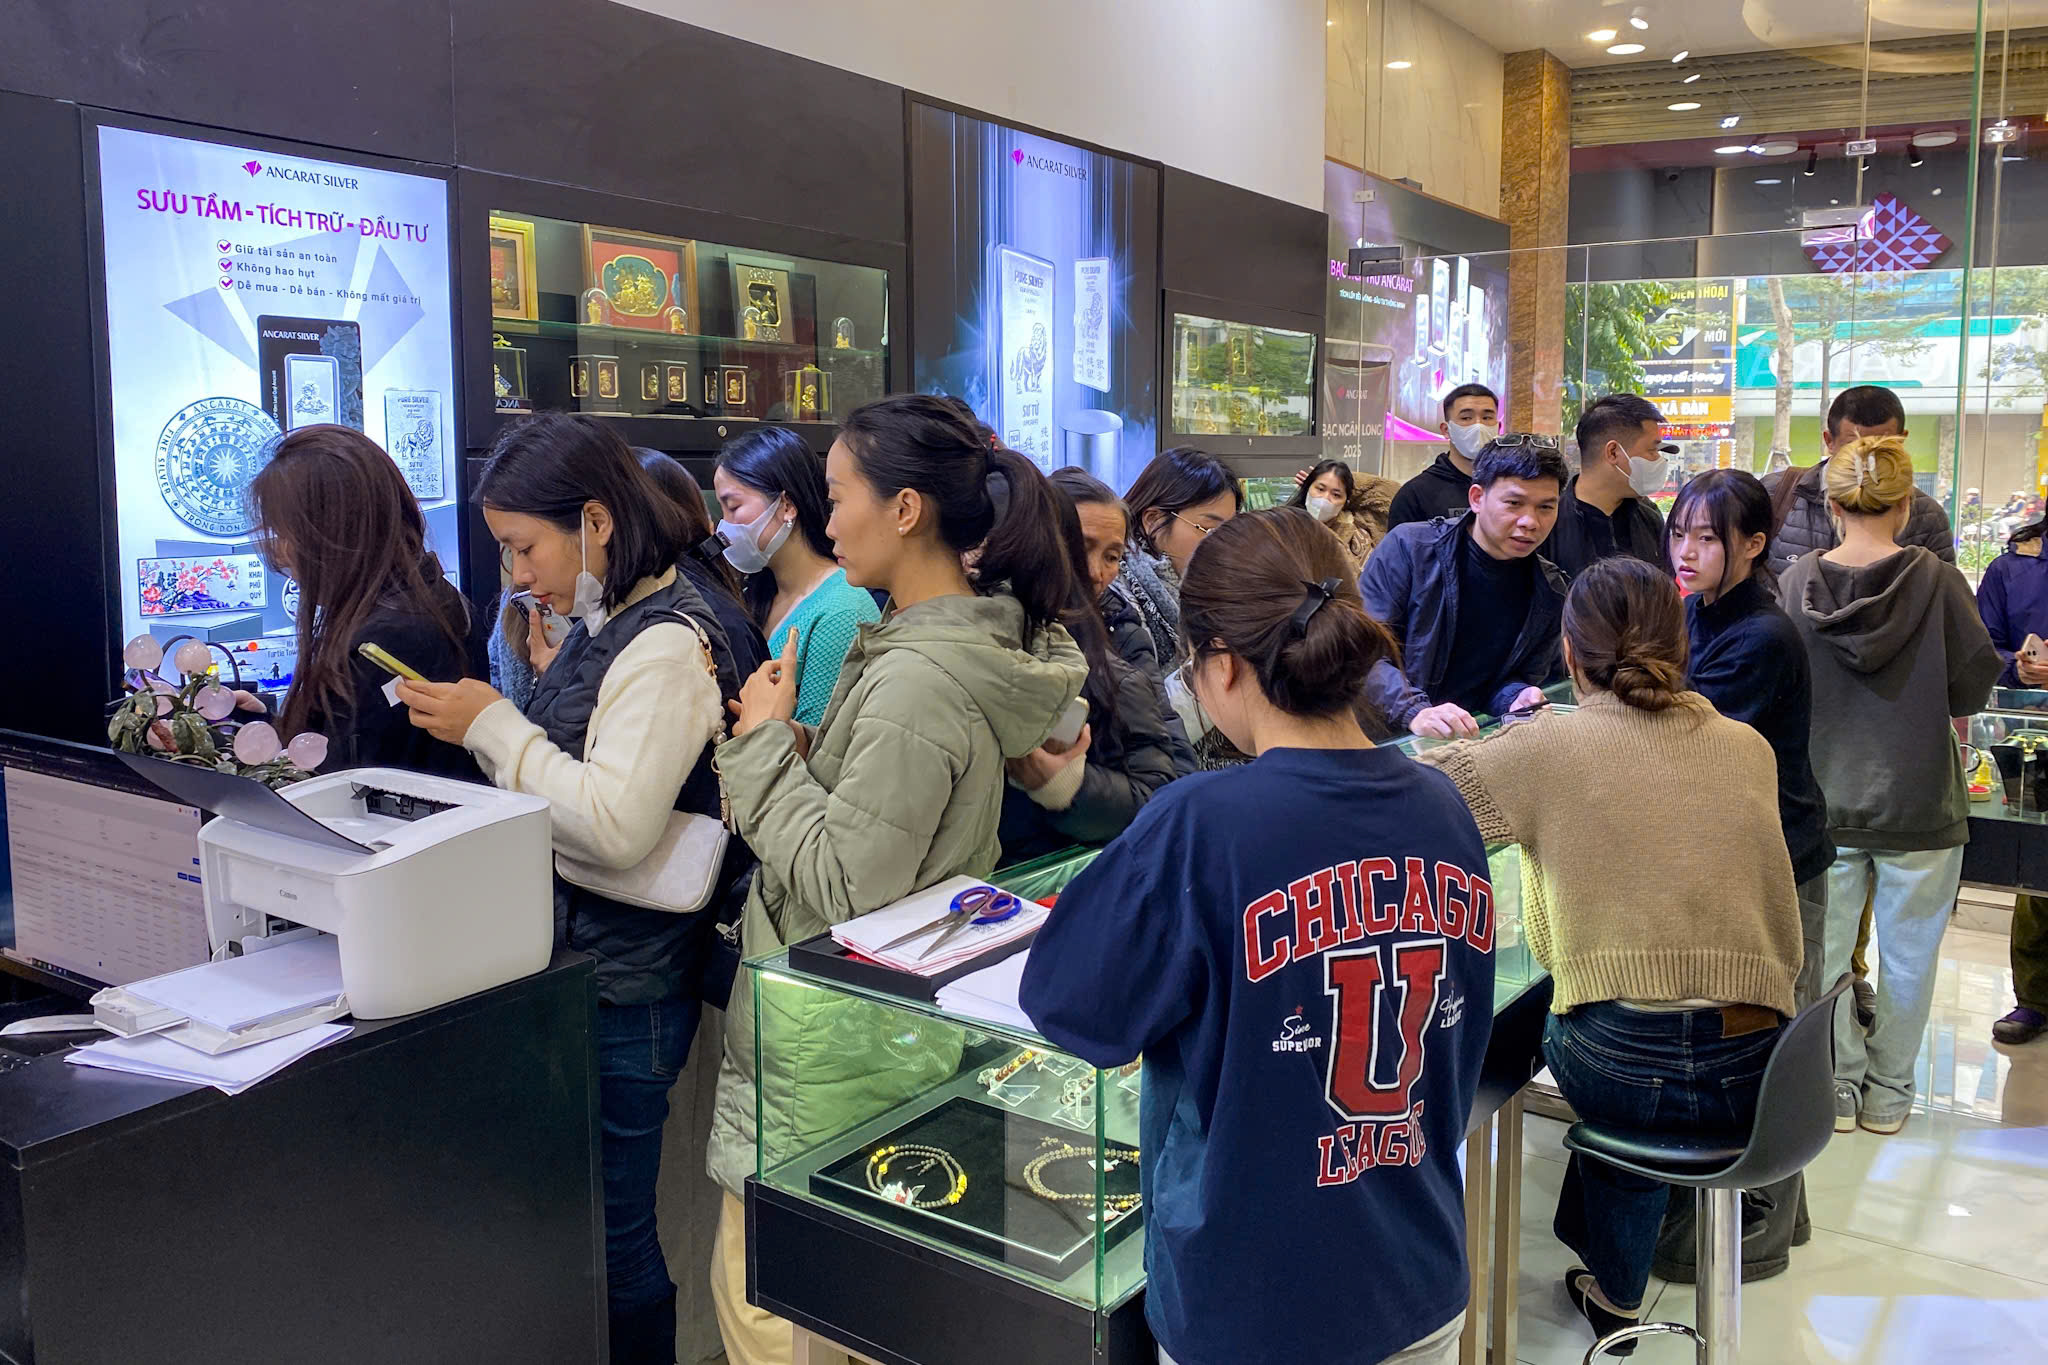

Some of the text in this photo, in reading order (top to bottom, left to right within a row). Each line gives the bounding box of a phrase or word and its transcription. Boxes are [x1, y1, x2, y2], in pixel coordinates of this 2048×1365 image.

[266, 166, 358, 190] ANCARAT SILVER
[1027, 154, 1086, 180] ANCARAT SILVER
[137, 188, 188, 214] SƯU
[191, 192, 242, 222] TẦM
[256, 203, 302, 228] TÍCH
[305, 212, 344, 232] TRỮ
[359, 215, 400, 240] ĐẦU
[403, 224, 428, 242] TƯ
[258, 246, 272, 256] tài
[314, 253, 337, 263] toàn
[236, 262, 315, 279] Không hao hụt
[1330, 260, 1346, 280] BẠC
[1381, 275, 1414, 292] ANCARAT
[256, 284, 278, 292] mua
[307, 286, 325, 296] bán
[336, 290, 368, 302] Không
[372, 292, 389, 302] mất
[392, 295, 406, 304] giá
[262, 330, 319, 341] ANCARAT SILVER
[1704, 328, 1726, 342] MỚI
[194, 400, 246, 414] ANCARAT
[1362, 424, 1382, 436] LONG
[158, 428, 174, 494] FINE SILVER
[183, 512, 214, 532] TRONG
[1243, 857, 1496, 983] CHICAGO
[1324, 938, 1447, 1122] U
[1317, 1099, 1426, 1188] LEAGU
